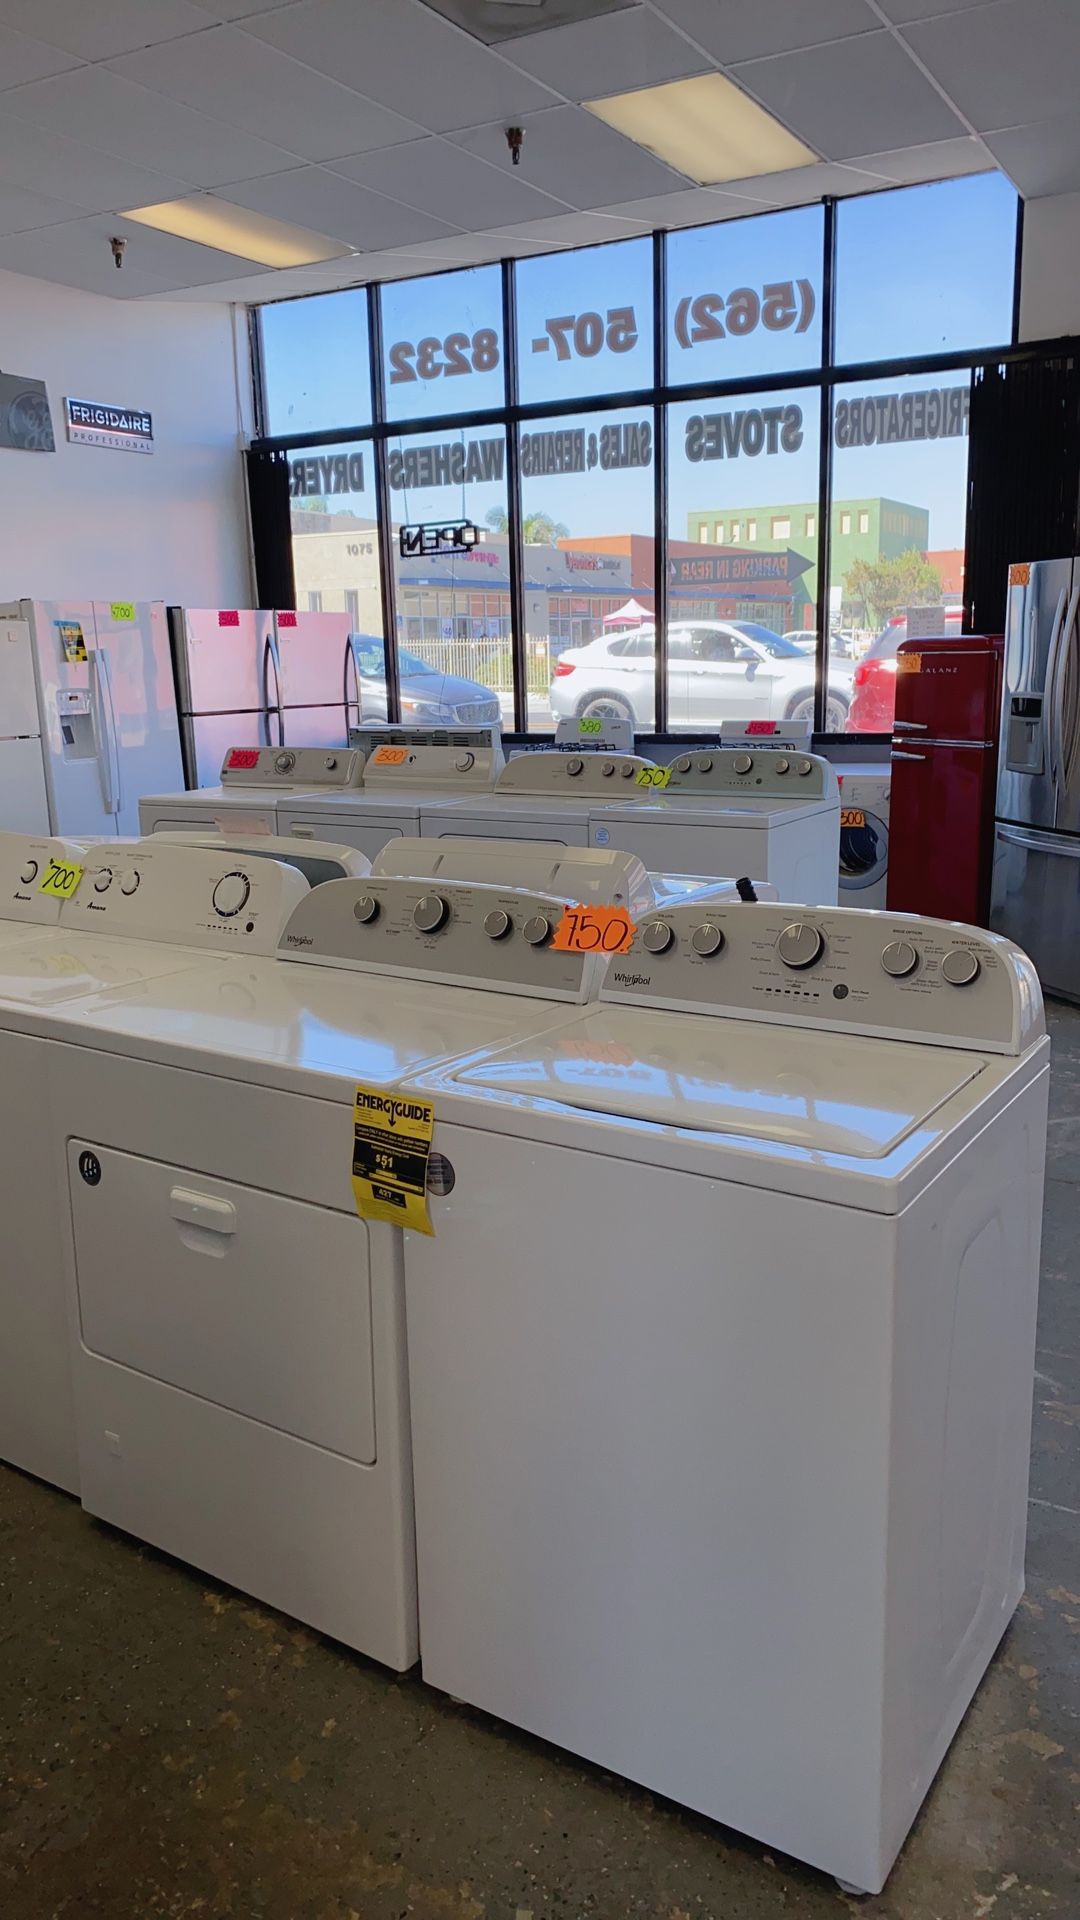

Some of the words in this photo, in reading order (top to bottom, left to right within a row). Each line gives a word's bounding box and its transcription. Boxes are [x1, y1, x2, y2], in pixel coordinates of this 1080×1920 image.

[72, 405, 151, 432] FRIGIDAIRE
[74, 432, 151, 450] PROFESSIONAL
[921, 666, 958, 674] ALANZ
[638, 766, 666, 786] 750
[287, 935, 314, 947] Whirlpool
[614, 972, 651, 987] Whirlpool
